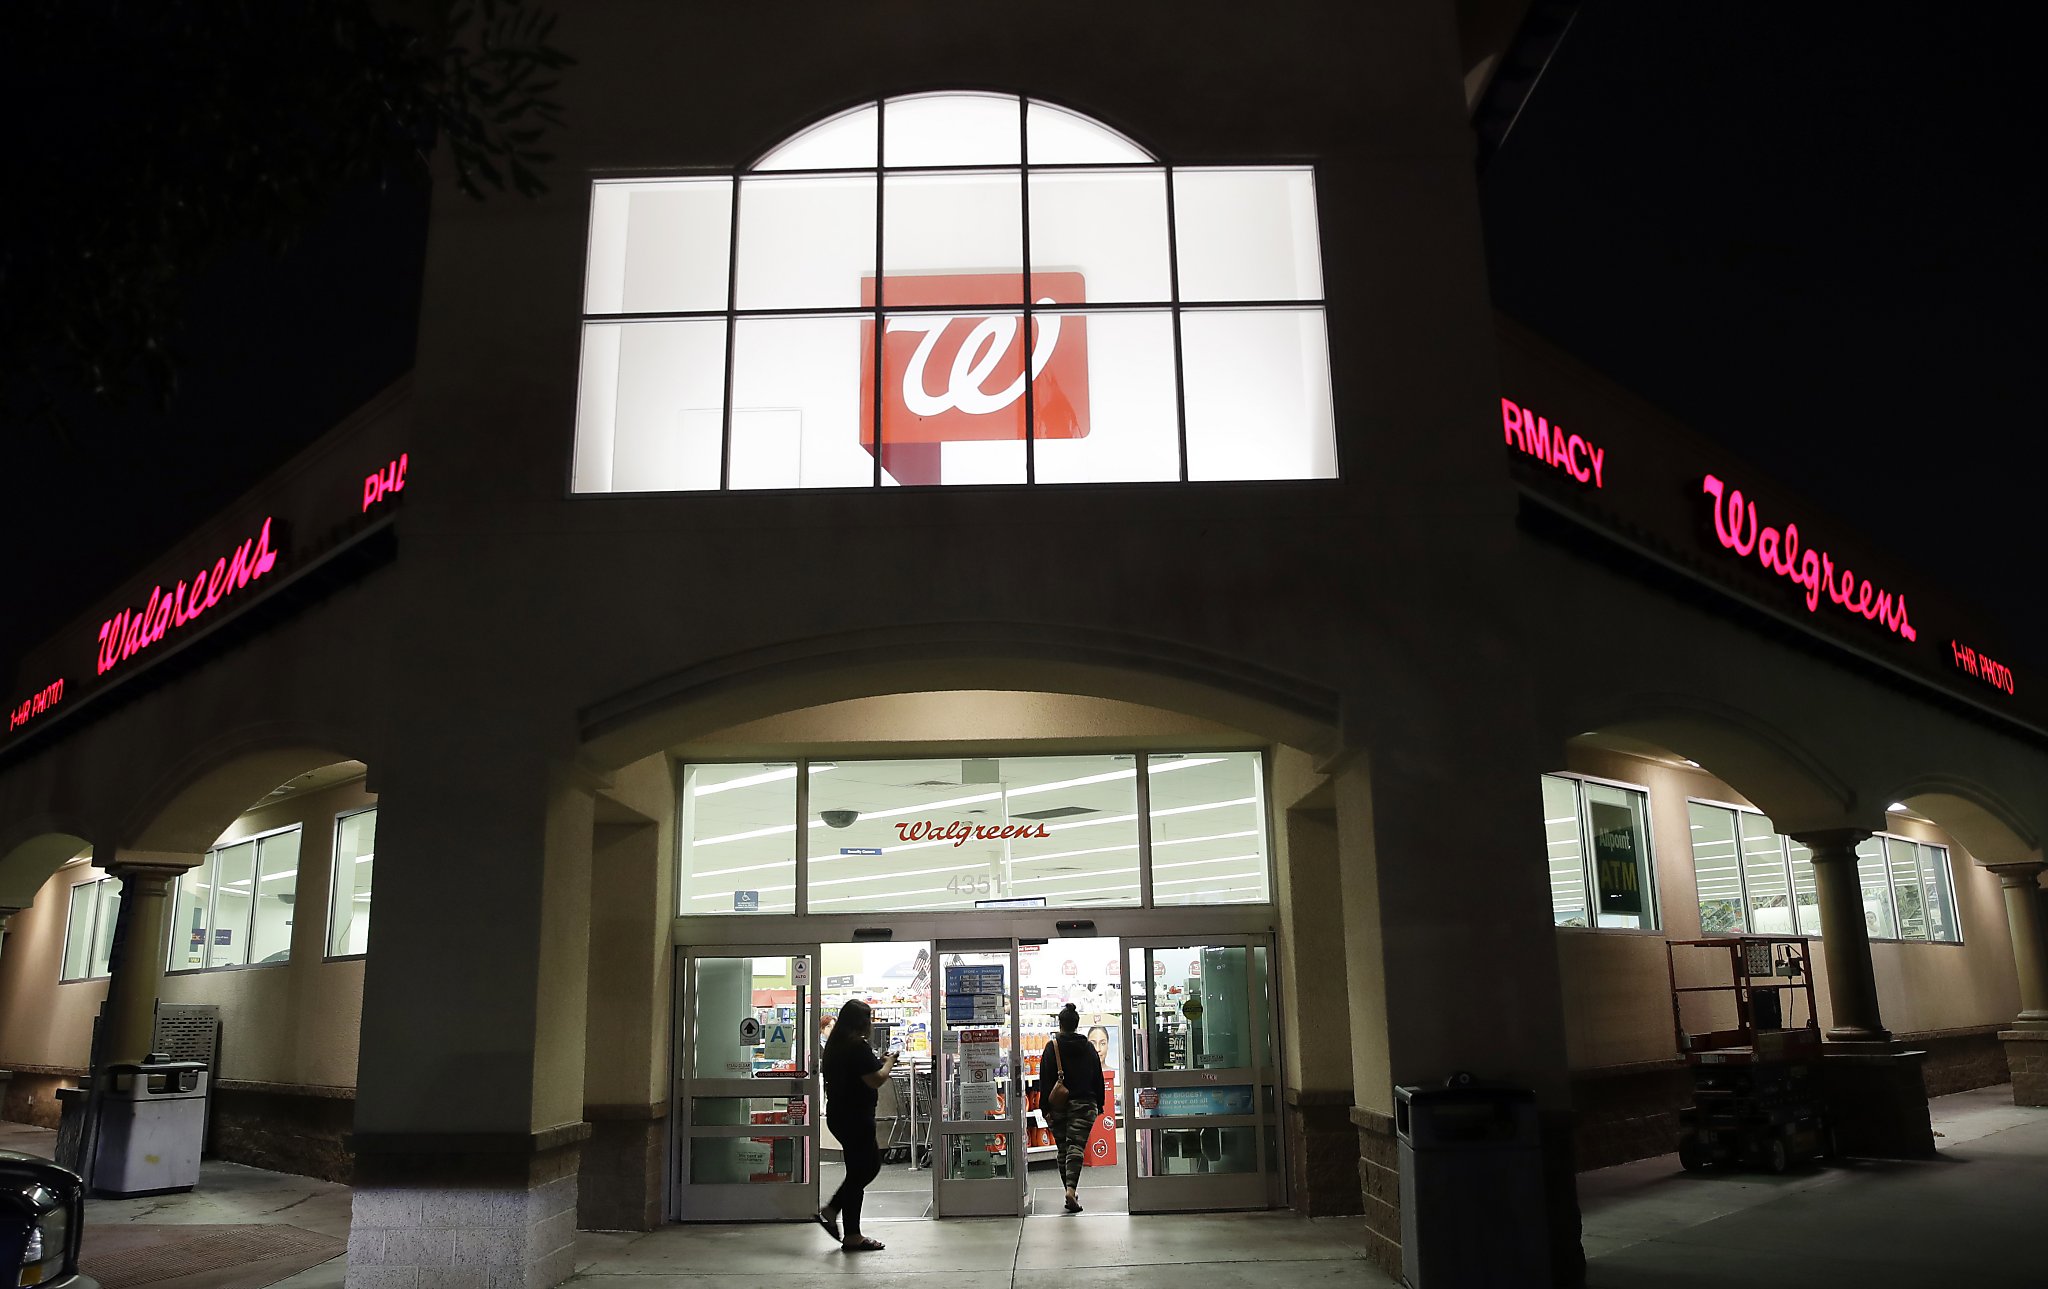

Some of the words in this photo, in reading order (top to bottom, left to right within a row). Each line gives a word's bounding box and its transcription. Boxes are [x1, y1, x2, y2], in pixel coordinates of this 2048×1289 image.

[1500, 397, 1605, 489] RMACY
[1702, 473, 1917, 643] Walgreens
[97, 516, 278, 676] Walgreens
[1951, 639, 1979, 677] 1-HR
[1978, 653, 2015, 695] PHOTO
[10, 699, 32, 731] 1-HR
[31, 678, 65, 718] PHOTO
[894, 819, 1052, 848] Walgreens
[1599, 827, 1629, 852] Allpoint
[946, 873, 1002, 896] 4351
[1601, 860, 1637, 891] ATM
[770, 1025, 787, 1043] A
